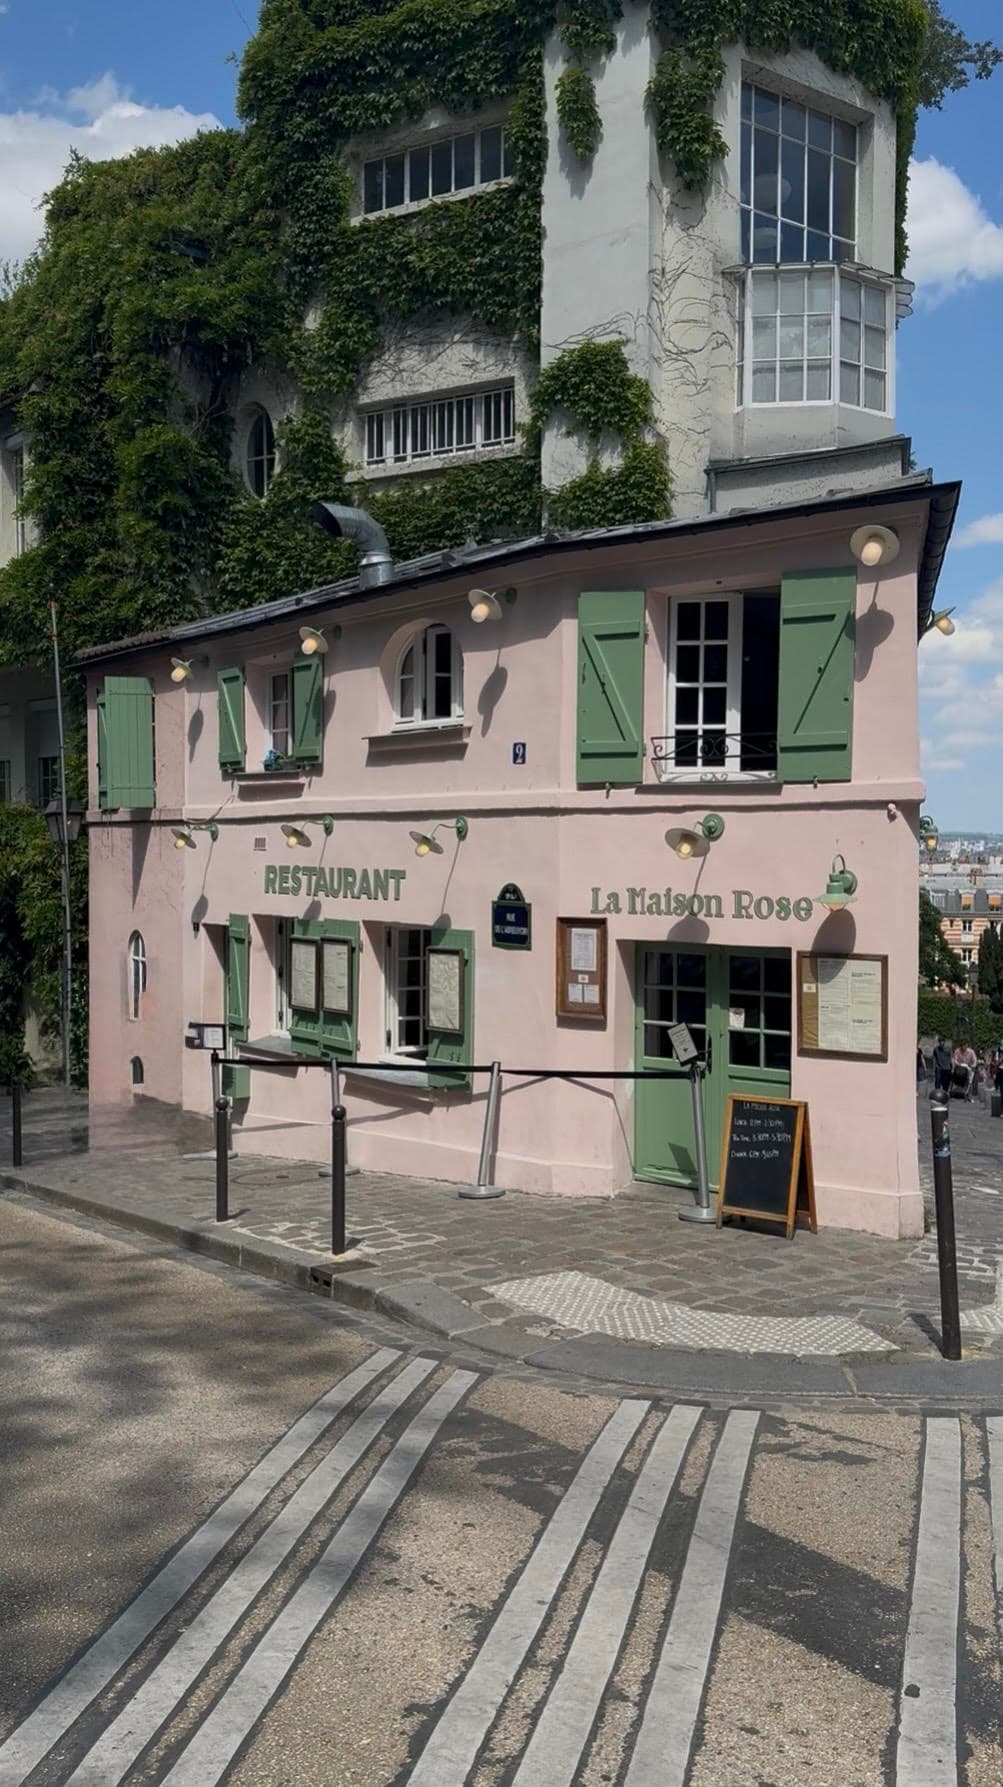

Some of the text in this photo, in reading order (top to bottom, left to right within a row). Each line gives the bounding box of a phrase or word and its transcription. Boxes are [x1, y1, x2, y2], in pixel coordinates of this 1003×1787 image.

[515, 744, 524, 763] 2
[265, 865, 406, 901] RESTAURANT
[590, 887, 813, 921] La Maison Rose
